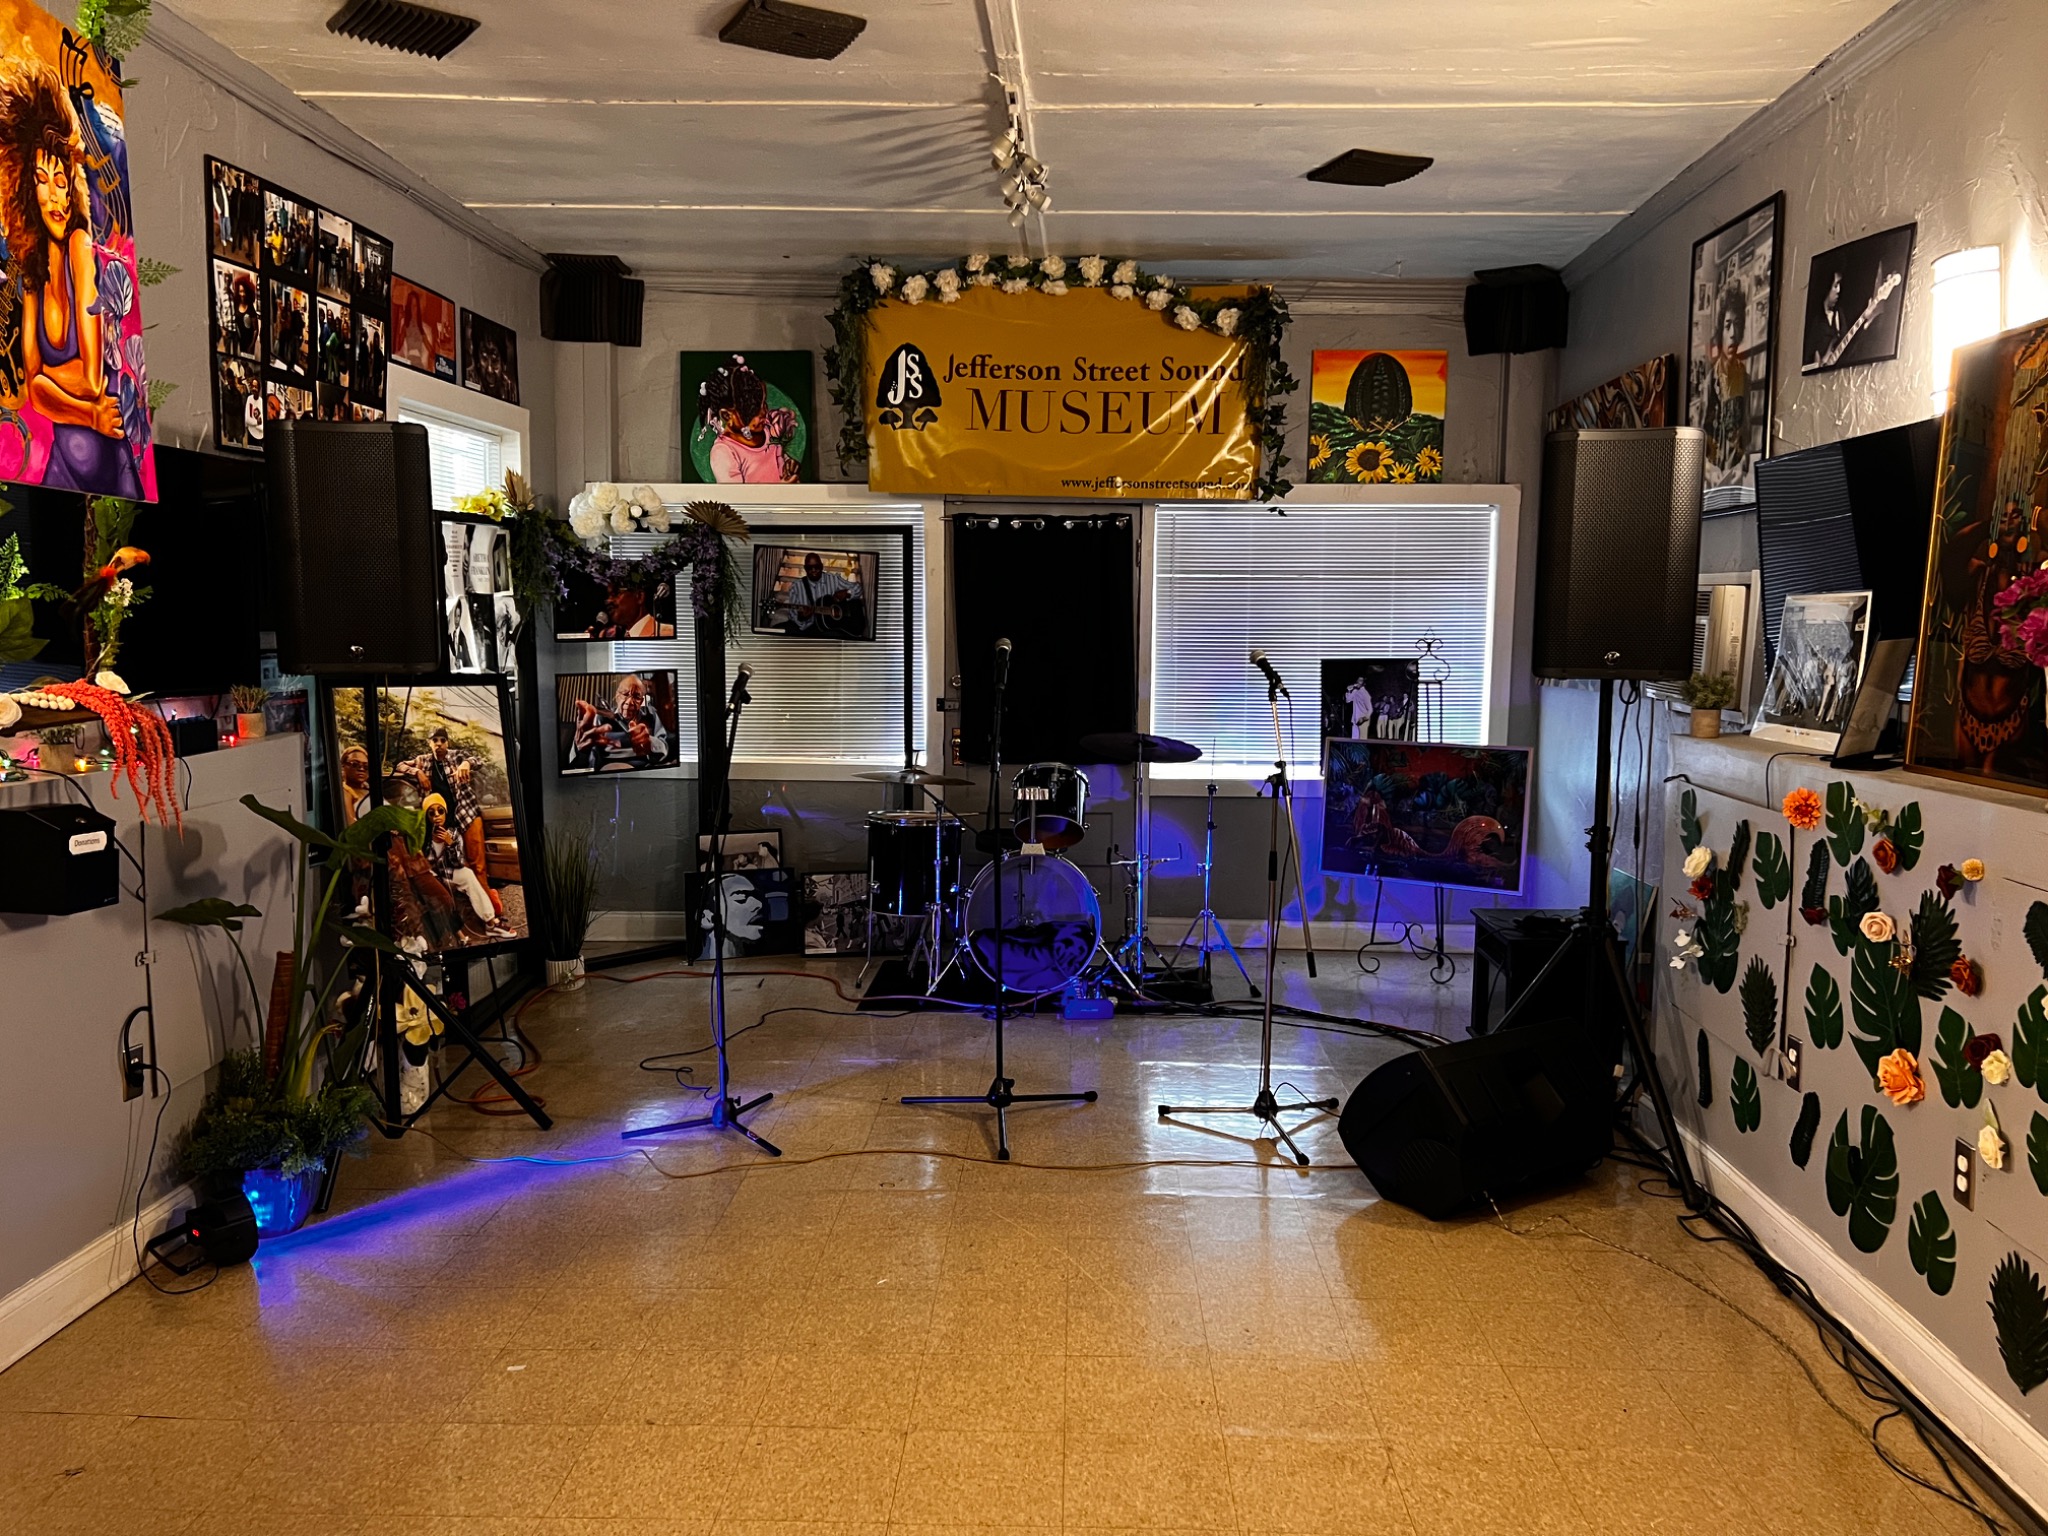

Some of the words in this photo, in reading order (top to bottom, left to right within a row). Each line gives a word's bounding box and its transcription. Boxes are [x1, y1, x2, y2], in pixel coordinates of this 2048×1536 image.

[942, 353, 1061, 383] Jefferson
[1073, 357, 1151, 382] Street
[1160, 356, 1245, 382] Sound
[965, 388, 1228, 435] MUSEUM
